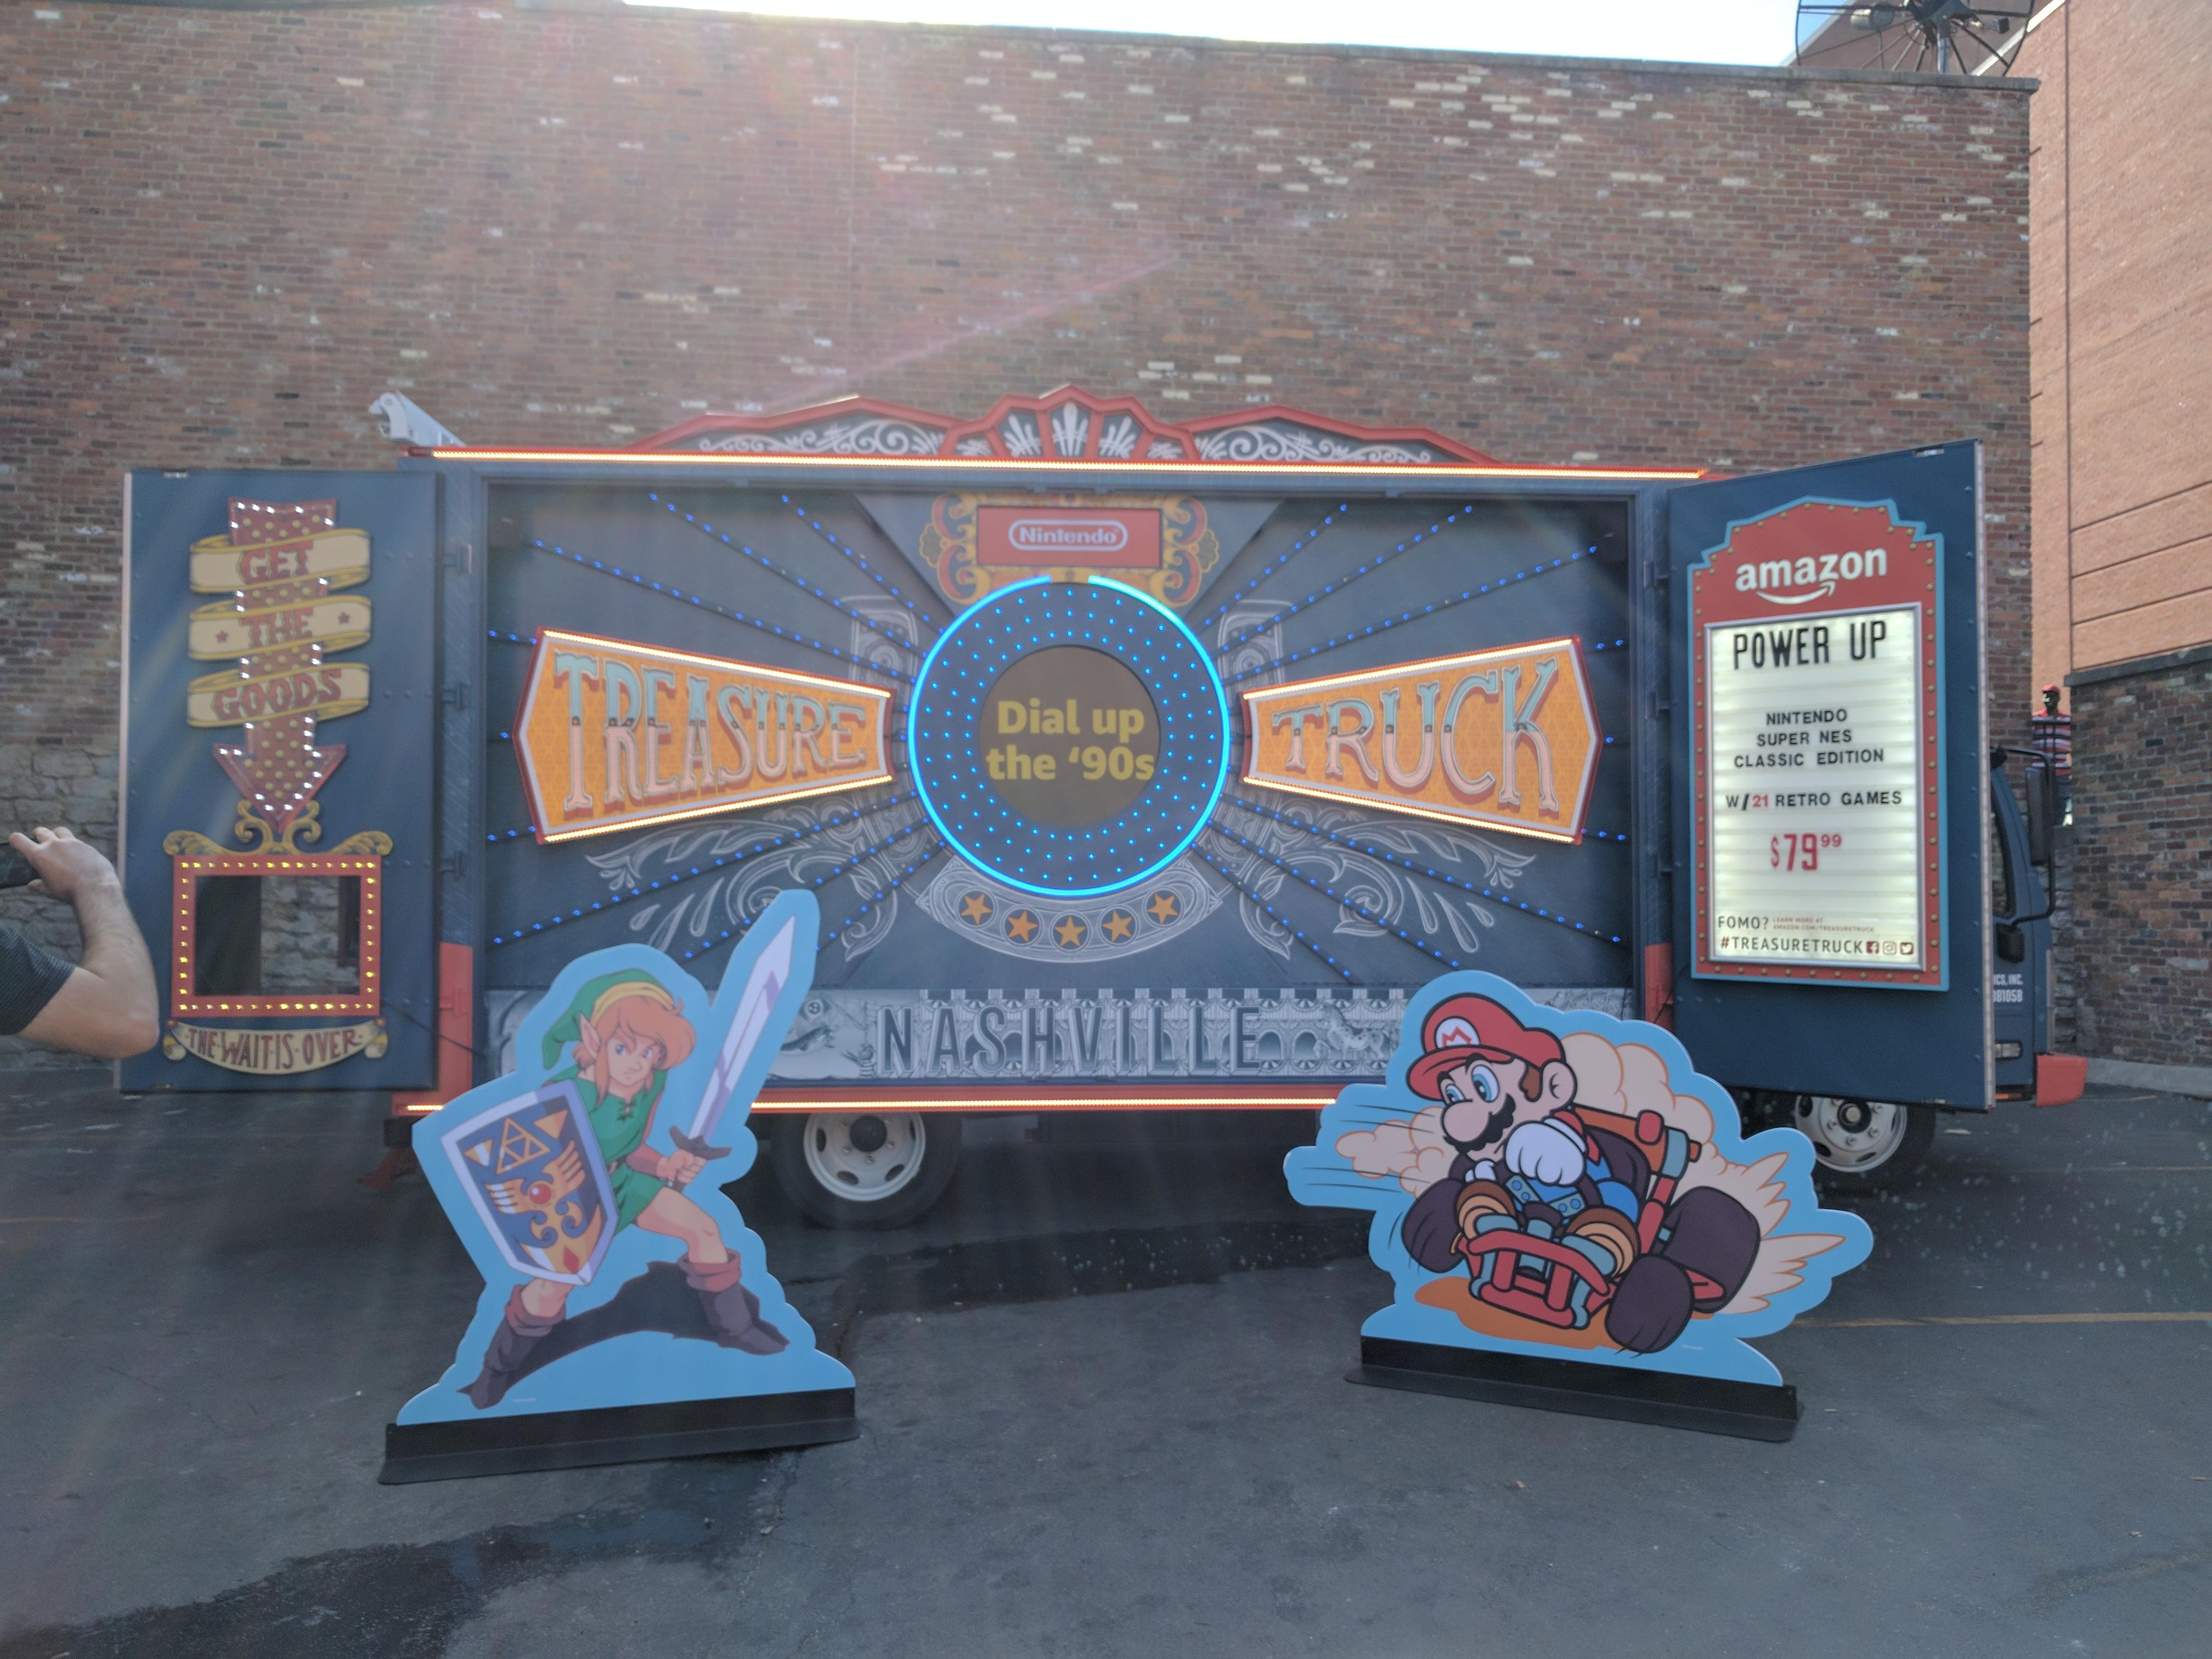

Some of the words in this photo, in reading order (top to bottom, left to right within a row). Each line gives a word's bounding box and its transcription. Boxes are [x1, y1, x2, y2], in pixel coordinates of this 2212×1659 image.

[1020, 526, 1116, 544] Nintendo
[236, 540, 314, 585] GET
[1735, 548, 1887, 592] amazon
[240, 607, 315, 648] THE
[1733, 625, 1830, 670] POWER
[1849, 620, 1887, 661] UP
[212, 668, 343, 720] GOODS
[554, 648, 867, 815] TREASURE
[997, 698, 1081, 735] Dial
[1092, 707, 1145, 743] up
[1272, 657, 1559, 816] TRUCK
[1766, 709, 1848, 725] NINTENDO
[1734, 753, 1804, 768] CLASSIC
[1816, 748, 1884, 765] EDITION
[1757, 732, 1810, 747] SUPER
[1819, 730, 1853, 743] NES
[985, 745, 1057, 781] the
[1775, 792, 1831, 808] RETRO
[1841, 791, 1903, 806] GAMES
[1718, 916, 1769, 930] FOMO?
[1720, 936, 1864, 954] #TREASURETRUCK
[188, 1028, 218, 1059] THE
[221, 1031, 273, 1069] WAIT
[275, 1032, 294, 1069] IS
[302, 1028, 360, 1065] OVER
[878, 1005, 1262, 1077] NASHVILLE
